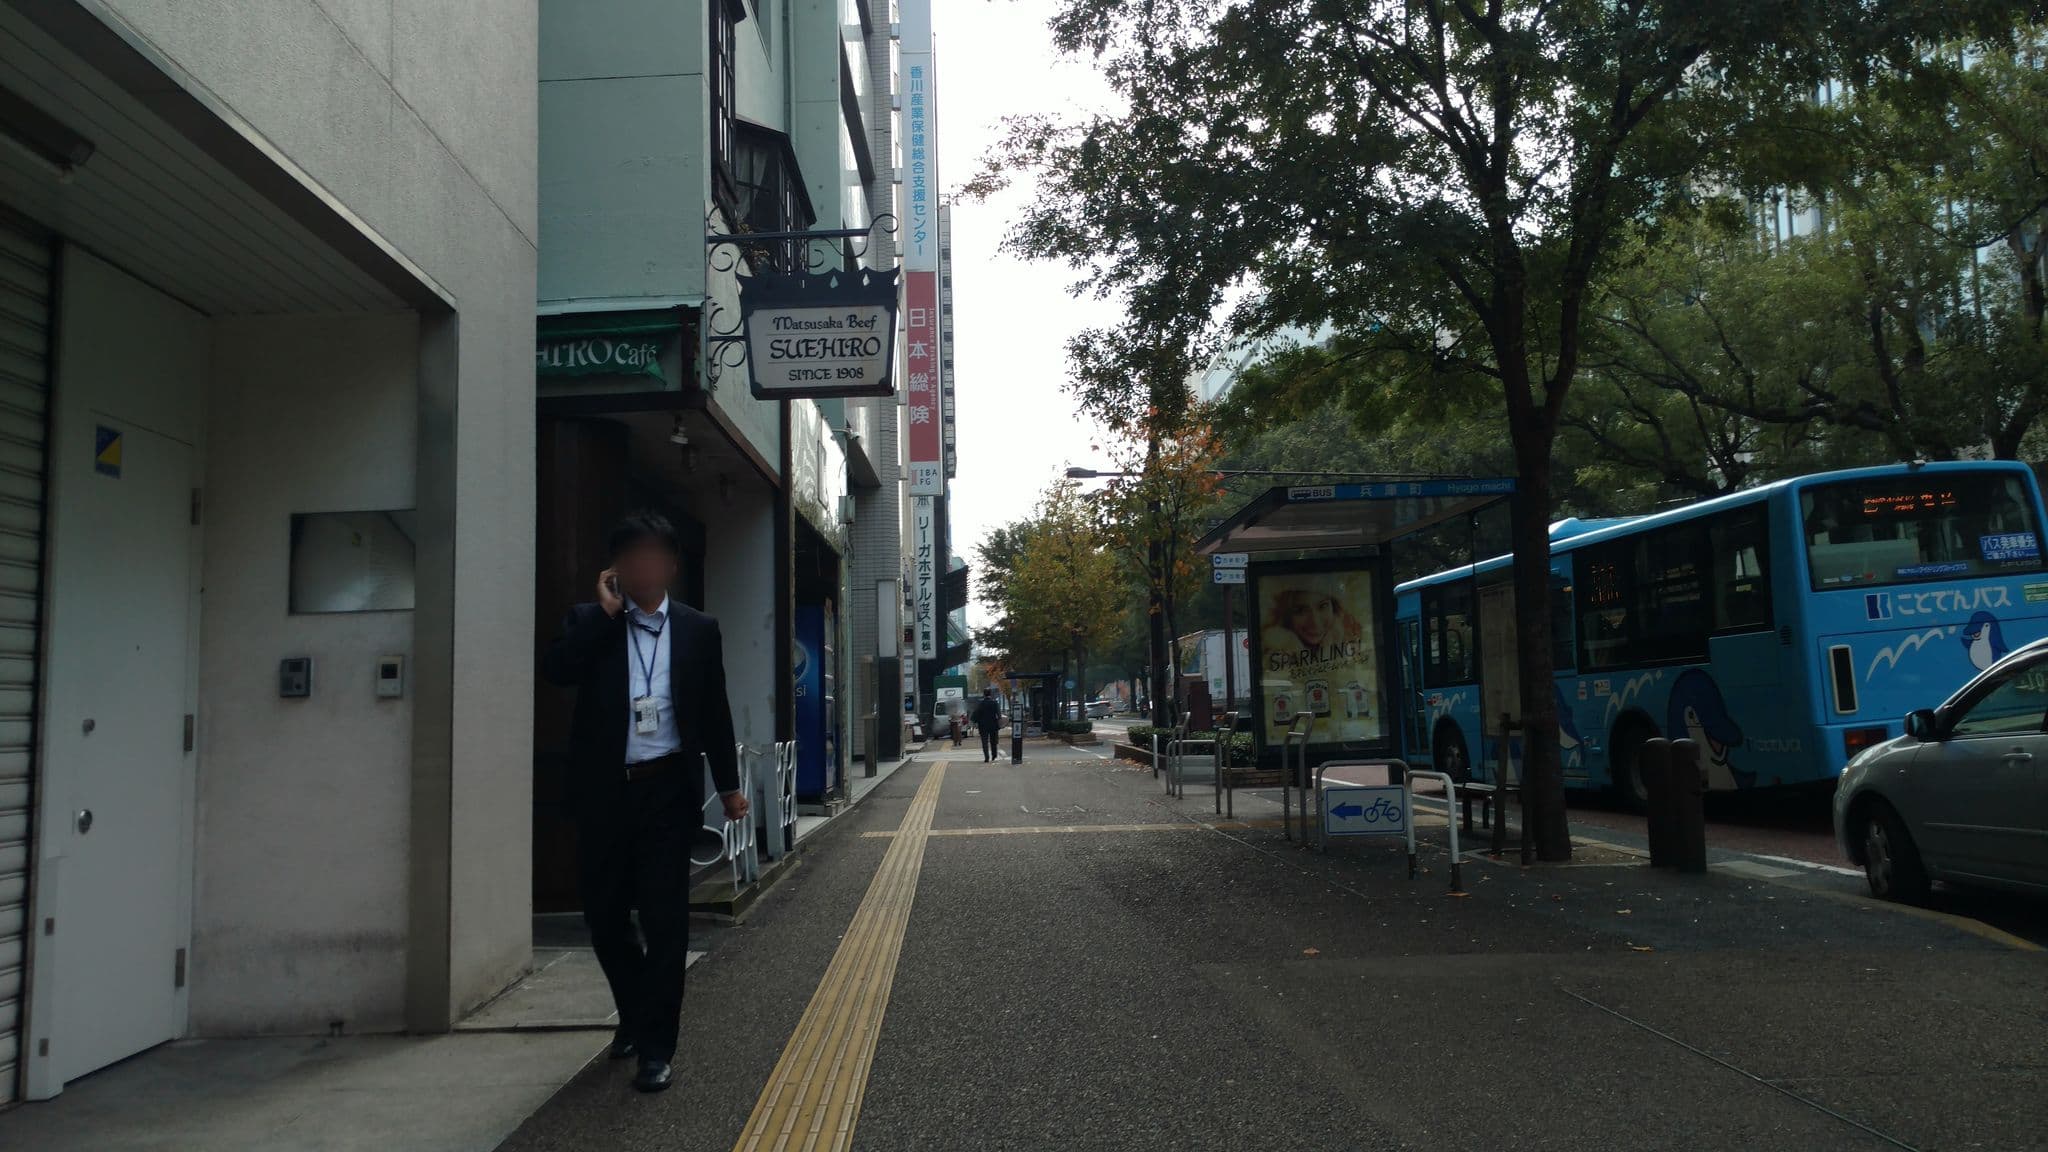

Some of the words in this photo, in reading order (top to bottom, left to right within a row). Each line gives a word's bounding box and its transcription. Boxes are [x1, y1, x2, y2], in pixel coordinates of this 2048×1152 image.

[910, 66, 926, 255] 香川産業保健総合支援センター
[772, 316, 843, 330] Matsusaka
[846, 314, 877, 330] Beef
[770, 336, 881, 359] SUEHIRO
[788, 368, 832, 381] SINCE
[836, 367, 865, 379] 1908
[909, 308, 930, 425] 日本総険
[1312, 488, 1332, 497] BUS
[1898, 586, 2013, 615] ことでんバス
